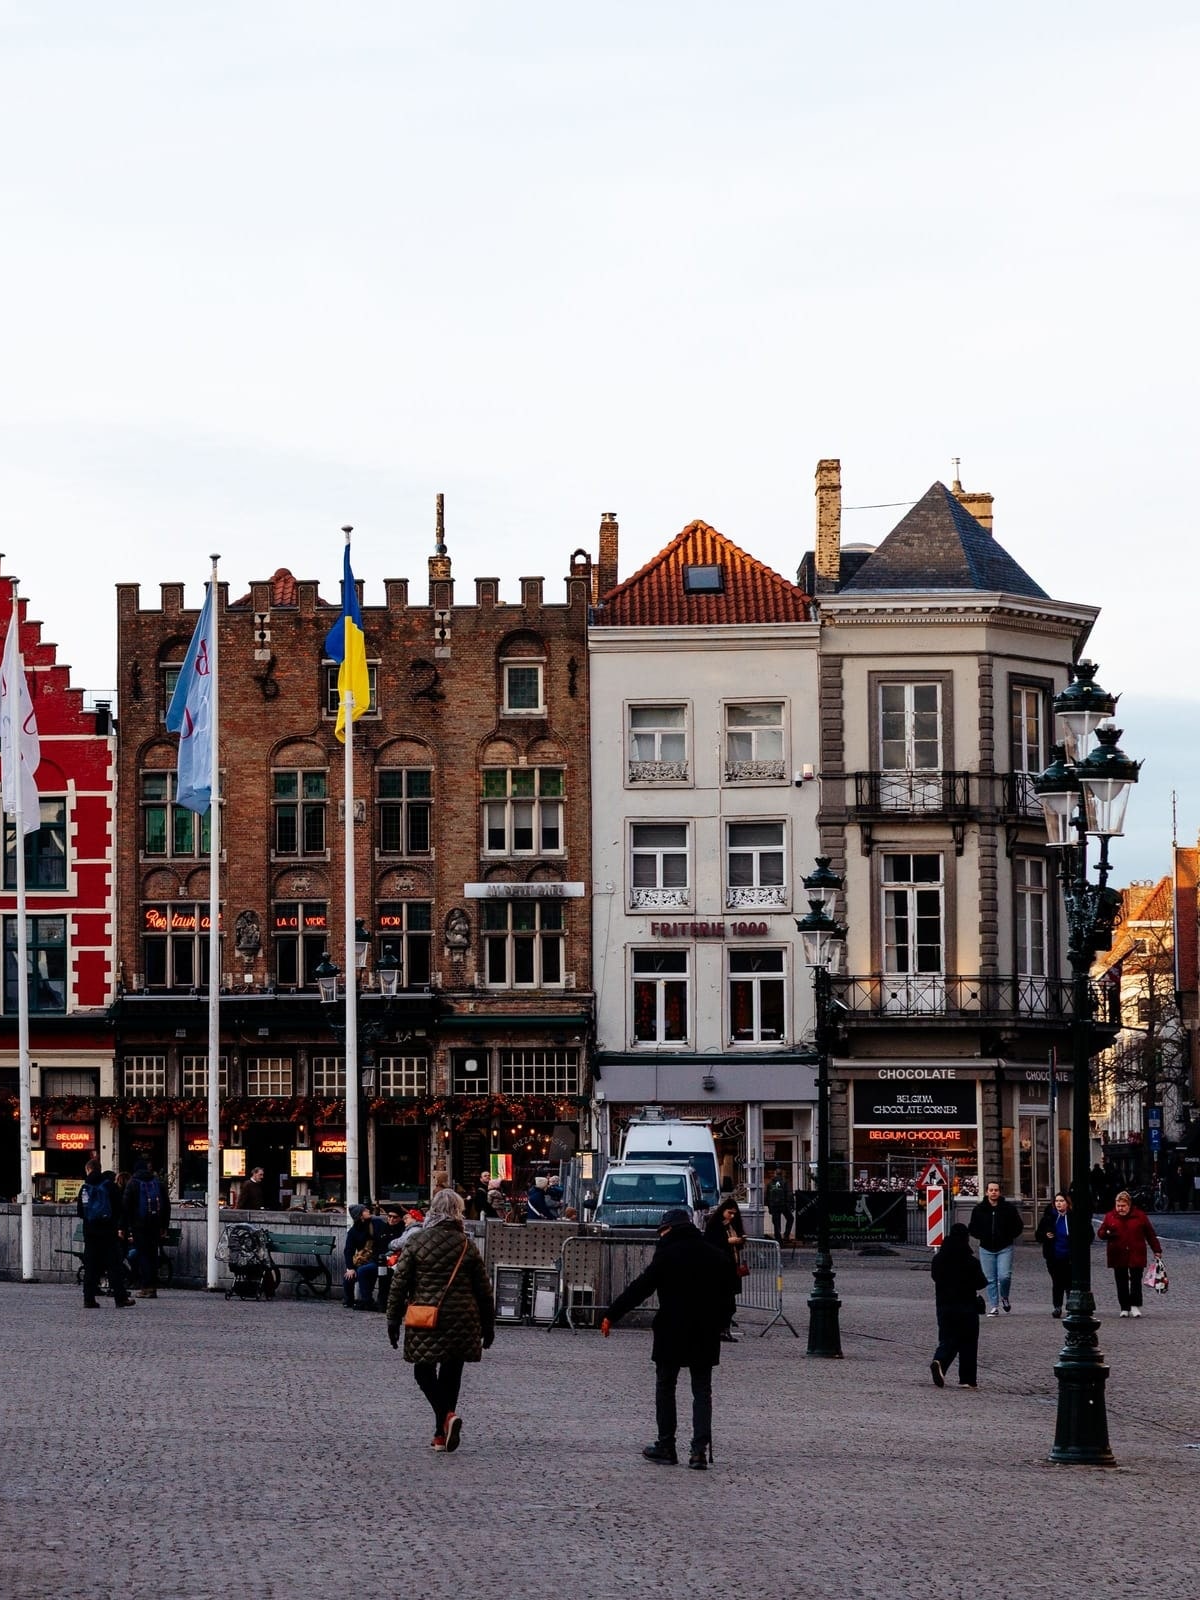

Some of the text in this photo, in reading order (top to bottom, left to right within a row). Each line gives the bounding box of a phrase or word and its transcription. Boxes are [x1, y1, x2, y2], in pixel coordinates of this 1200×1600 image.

[276, 918, 287, 927] LA
[650, 921, 726, 937] FRITERIE
[878, 1069, 956, 1080] CHOCOLATE
[1025, 1070, 1069, 1082] CHOCOATE
[896, 1095, 934, 1103] BELGIUM
[872, 1105, 958, 1114] CHOCOLATE CORNER
[55, 1133, 90, 1141] BELGIAN
[869, 1130, 961, 1140] BELGIUM CHOCOLATE
[1152, 1130, 1158, 1139] P
[61, 1142, 84, 1150] FOOD
